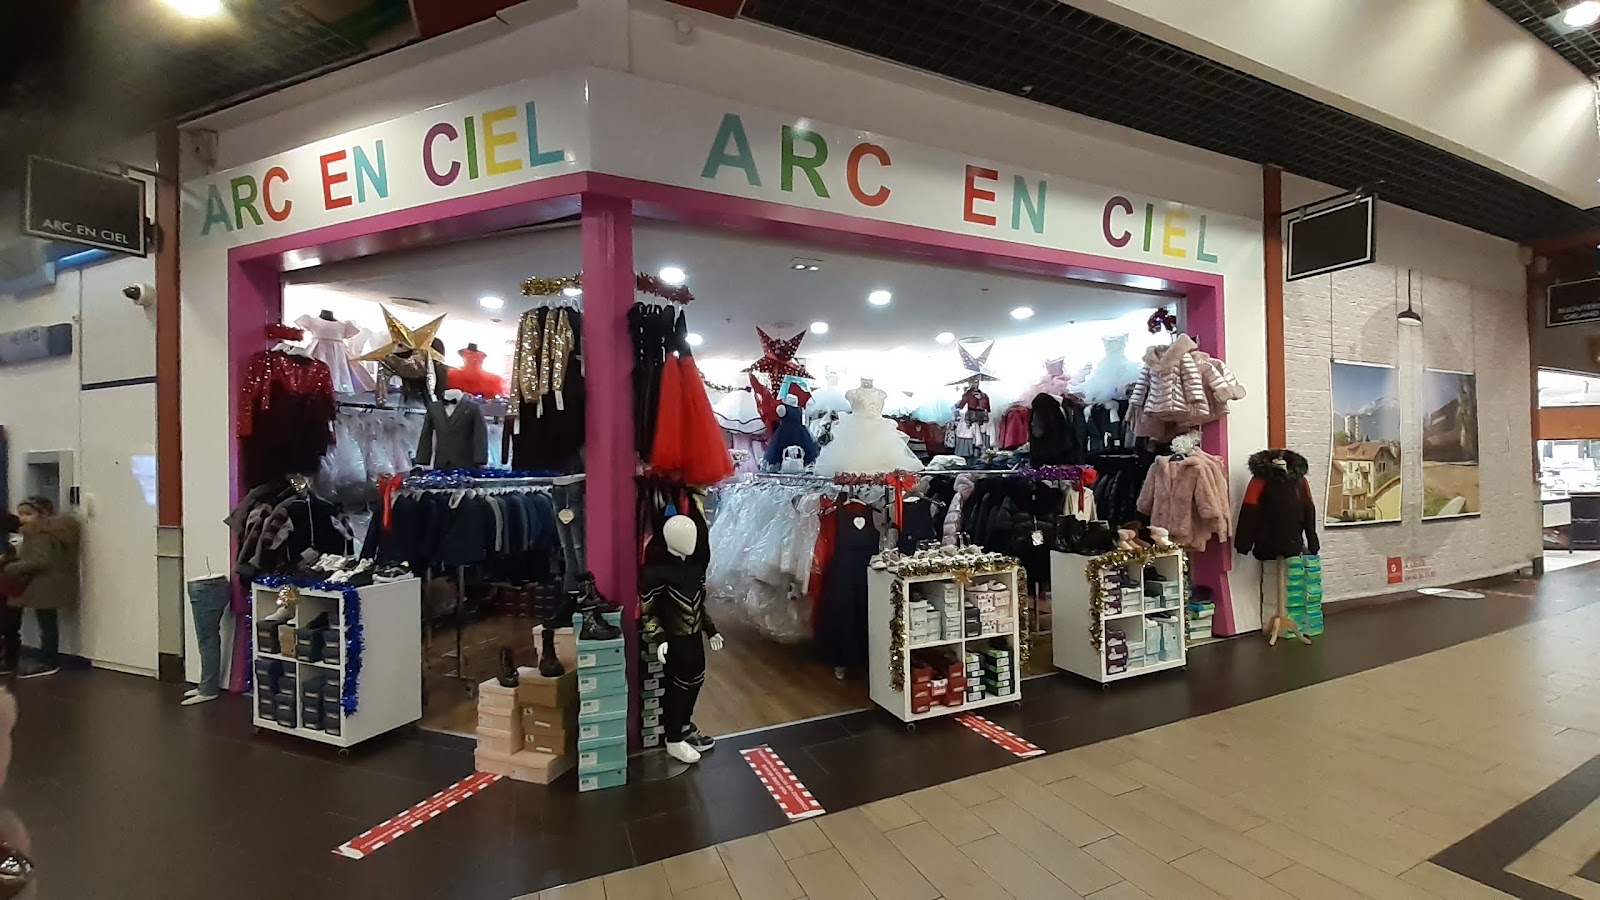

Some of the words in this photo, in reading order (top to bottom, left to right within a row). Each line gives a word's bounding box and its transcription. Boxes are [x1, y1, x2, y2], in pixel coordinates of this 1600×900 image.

[42, 219, 73, 233] ARC
[76, 224, 97, 238] EN
[101, 230, 129, 244] CIEL
[201, 165, 292, 236] ARC
[320, 139, 389, 211] EN
[422, 100, 565, 187] CIEL
[701, 112, 892, 207] ARC
[963, 164, 1047, 234] EN
[1102, 195, 1218, 264] CIEL
